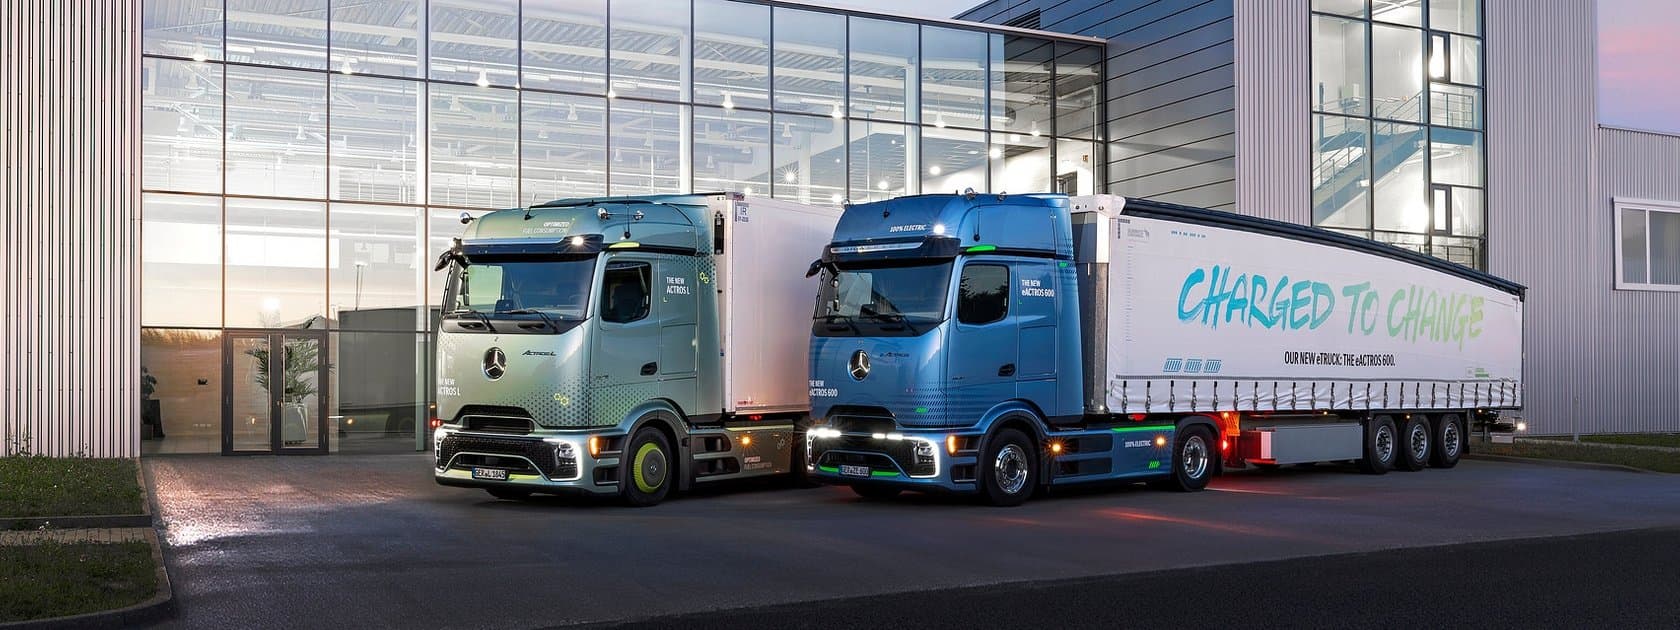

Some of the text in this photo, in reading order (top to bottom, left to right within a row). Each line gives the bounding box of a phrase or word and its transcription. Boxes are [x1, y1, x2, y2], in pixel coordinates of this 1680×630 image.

[675, 277, 685, 285] NEW
[666, 286, 686, 295] ACTROS
[1044, 289, 1055, 297] 600
[1178, 265, 1485, 350] CHARGED TO CHANGE
[1284, 351, 1396, 367] OUR NEW eTRUCK: THE eACTROS 600.
[828, 388, 839, 397] 600
